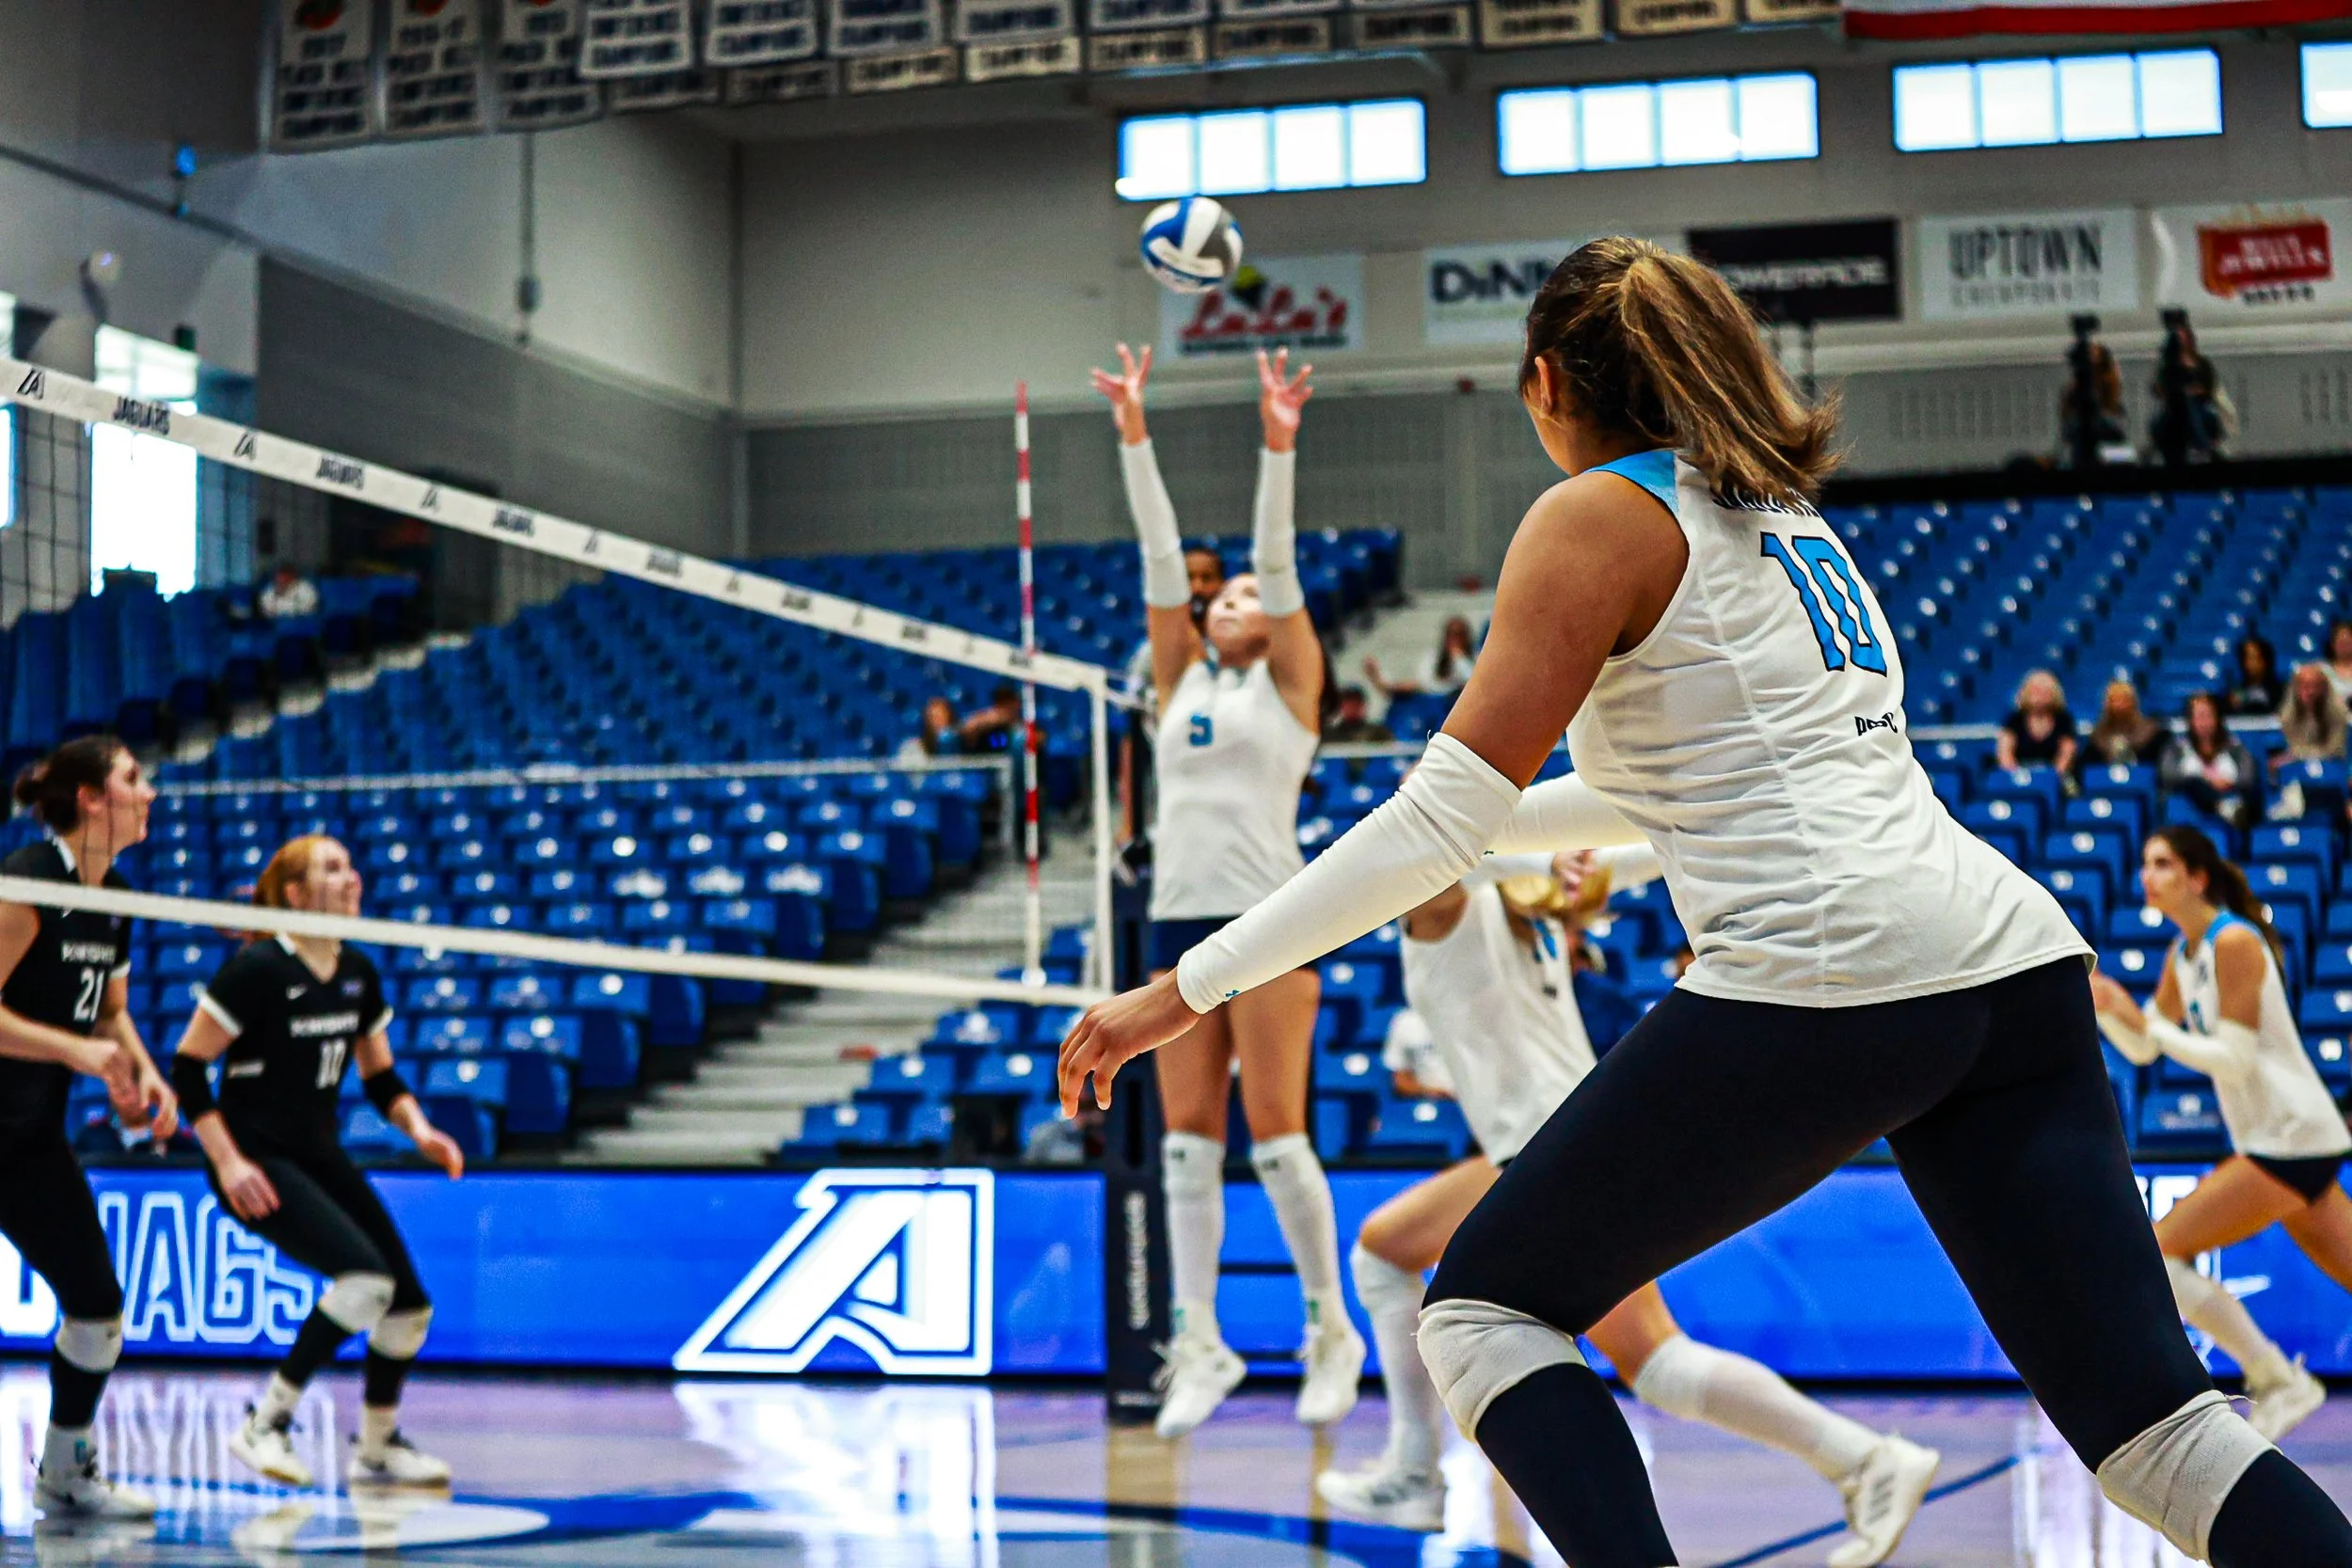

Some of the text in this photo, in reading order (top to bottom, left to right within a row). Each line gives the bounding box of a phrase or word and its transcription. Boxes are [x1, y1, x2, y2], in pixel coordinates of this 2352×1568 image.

[1947, 223, 2102, 279] UPTOWN
[1760, 531, 1887, 677] 10
[73, 967, 105, 1022] 21
